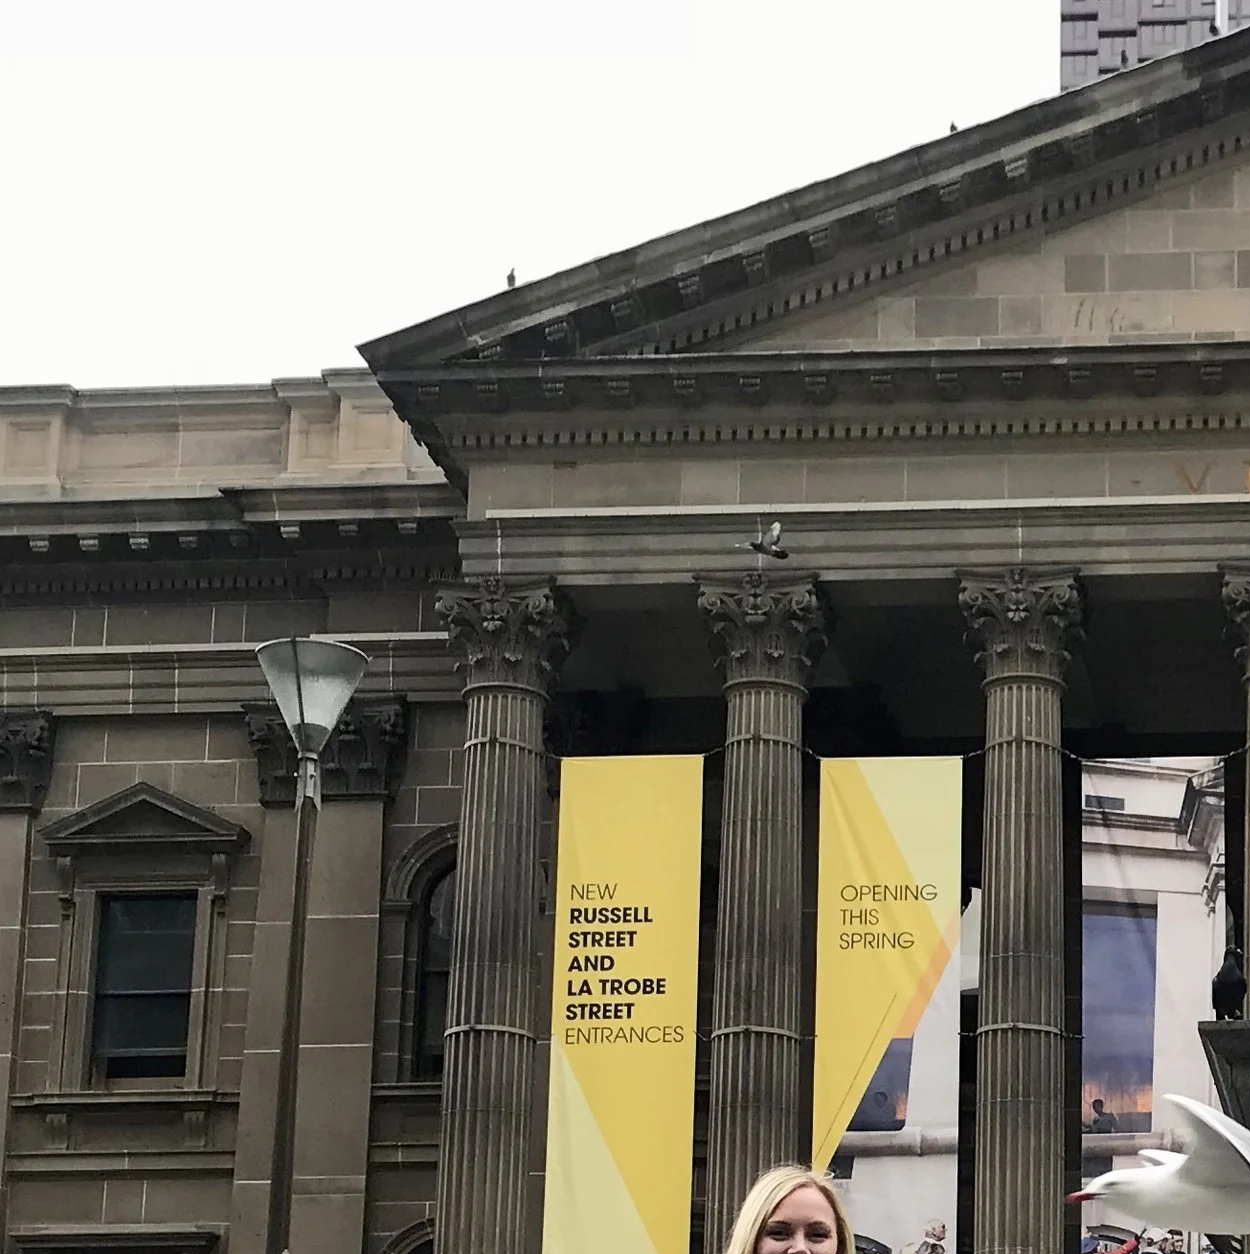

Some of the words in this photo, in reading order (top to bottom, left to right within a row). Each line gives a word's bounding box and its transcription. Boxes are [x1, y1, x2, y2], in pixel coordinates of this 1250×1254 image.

[570, 883, 618, 900] NEW
[840, 884, 938, 902] OPENING
[569, 907, 653, 924] RUSSELL
[840, 908, 879, 925] THIS
[568, 931, 637, 948] STREET
[839, 931, 915, 949] SPRING
[568, 955, 615, 972] AND
[567, 979, 593, 996] LA
[599, 978, 666, 995] TROBE
[565, 1003, 635, 1020] STREET
[565, 1025, 684, 1045] ENTRANCES
